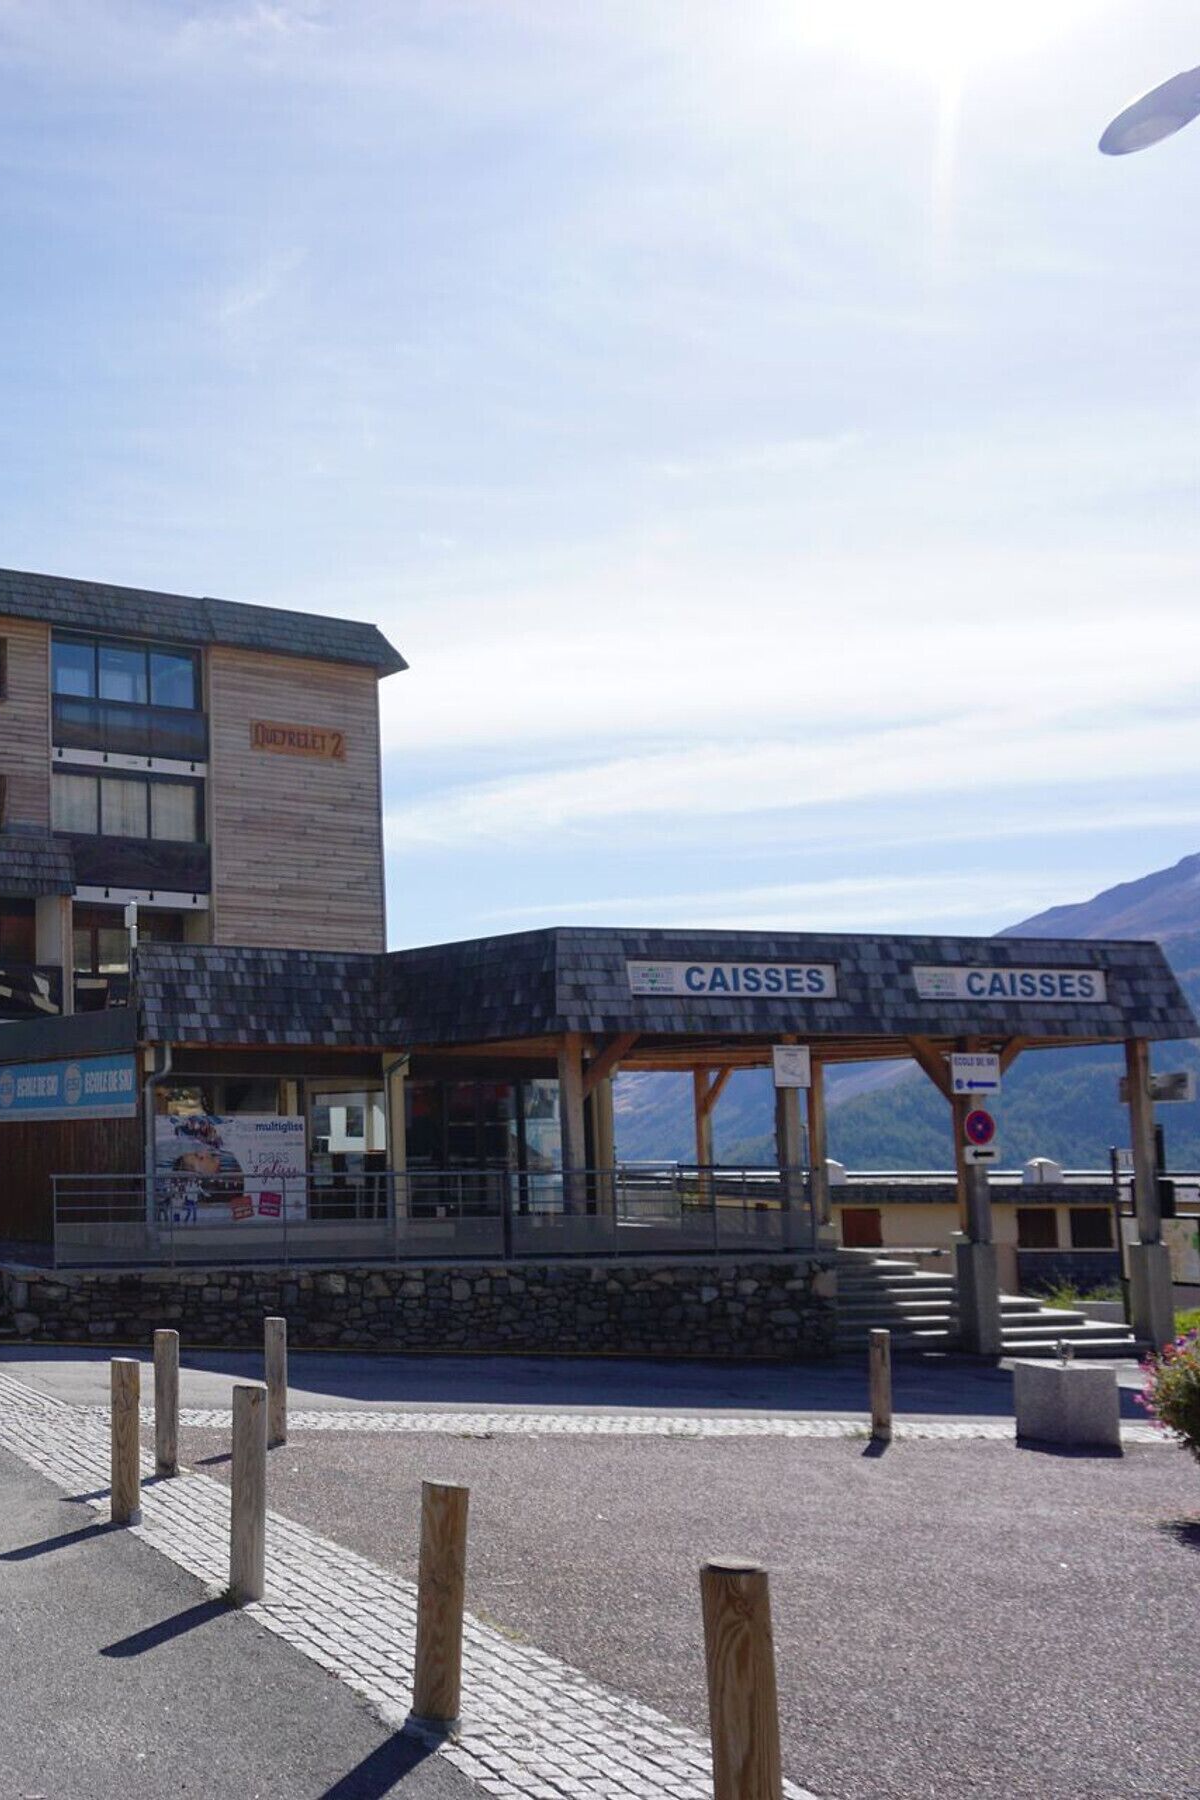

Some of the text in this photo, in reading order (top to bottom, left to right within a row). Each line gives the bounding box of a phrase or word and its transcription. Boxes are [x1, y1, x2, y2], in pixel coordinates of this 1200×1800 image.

[331, 732, 344, 757] 2
[684, 966, 826, 993] CAISSES
[966, 971, 1095, 998] CAISSES
[255, 1121, 304, 1134] multigliss
